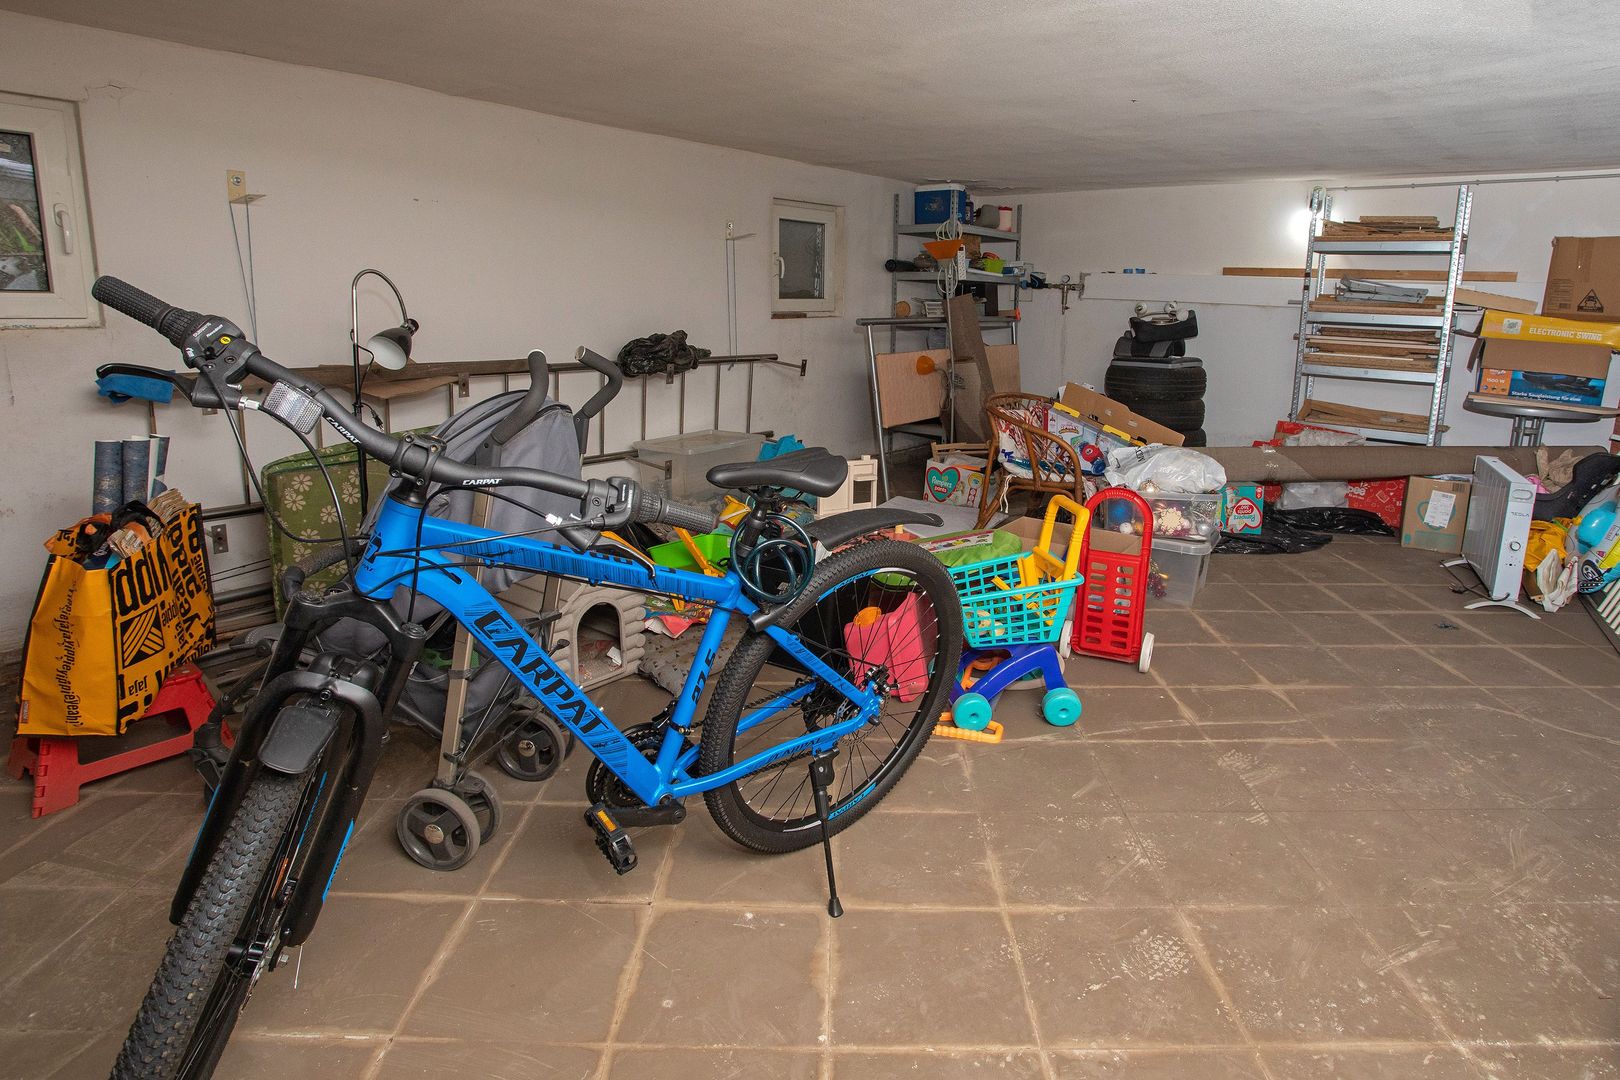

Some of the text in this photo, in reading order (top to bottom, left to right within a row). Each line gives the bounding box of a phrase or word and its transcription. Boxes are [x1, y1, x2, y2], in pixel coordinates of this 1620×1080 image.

[1529, 327, 1602, 341] ELECTRONIC SWING
[326, 416, 362, 444] CARPAT
[462, 478, 503, 486] CARPAT
[931, 475, 953, 489] Pampers
[473, 610, 609, 734] CARPAT
[128, 675, 148, 697] jaja
